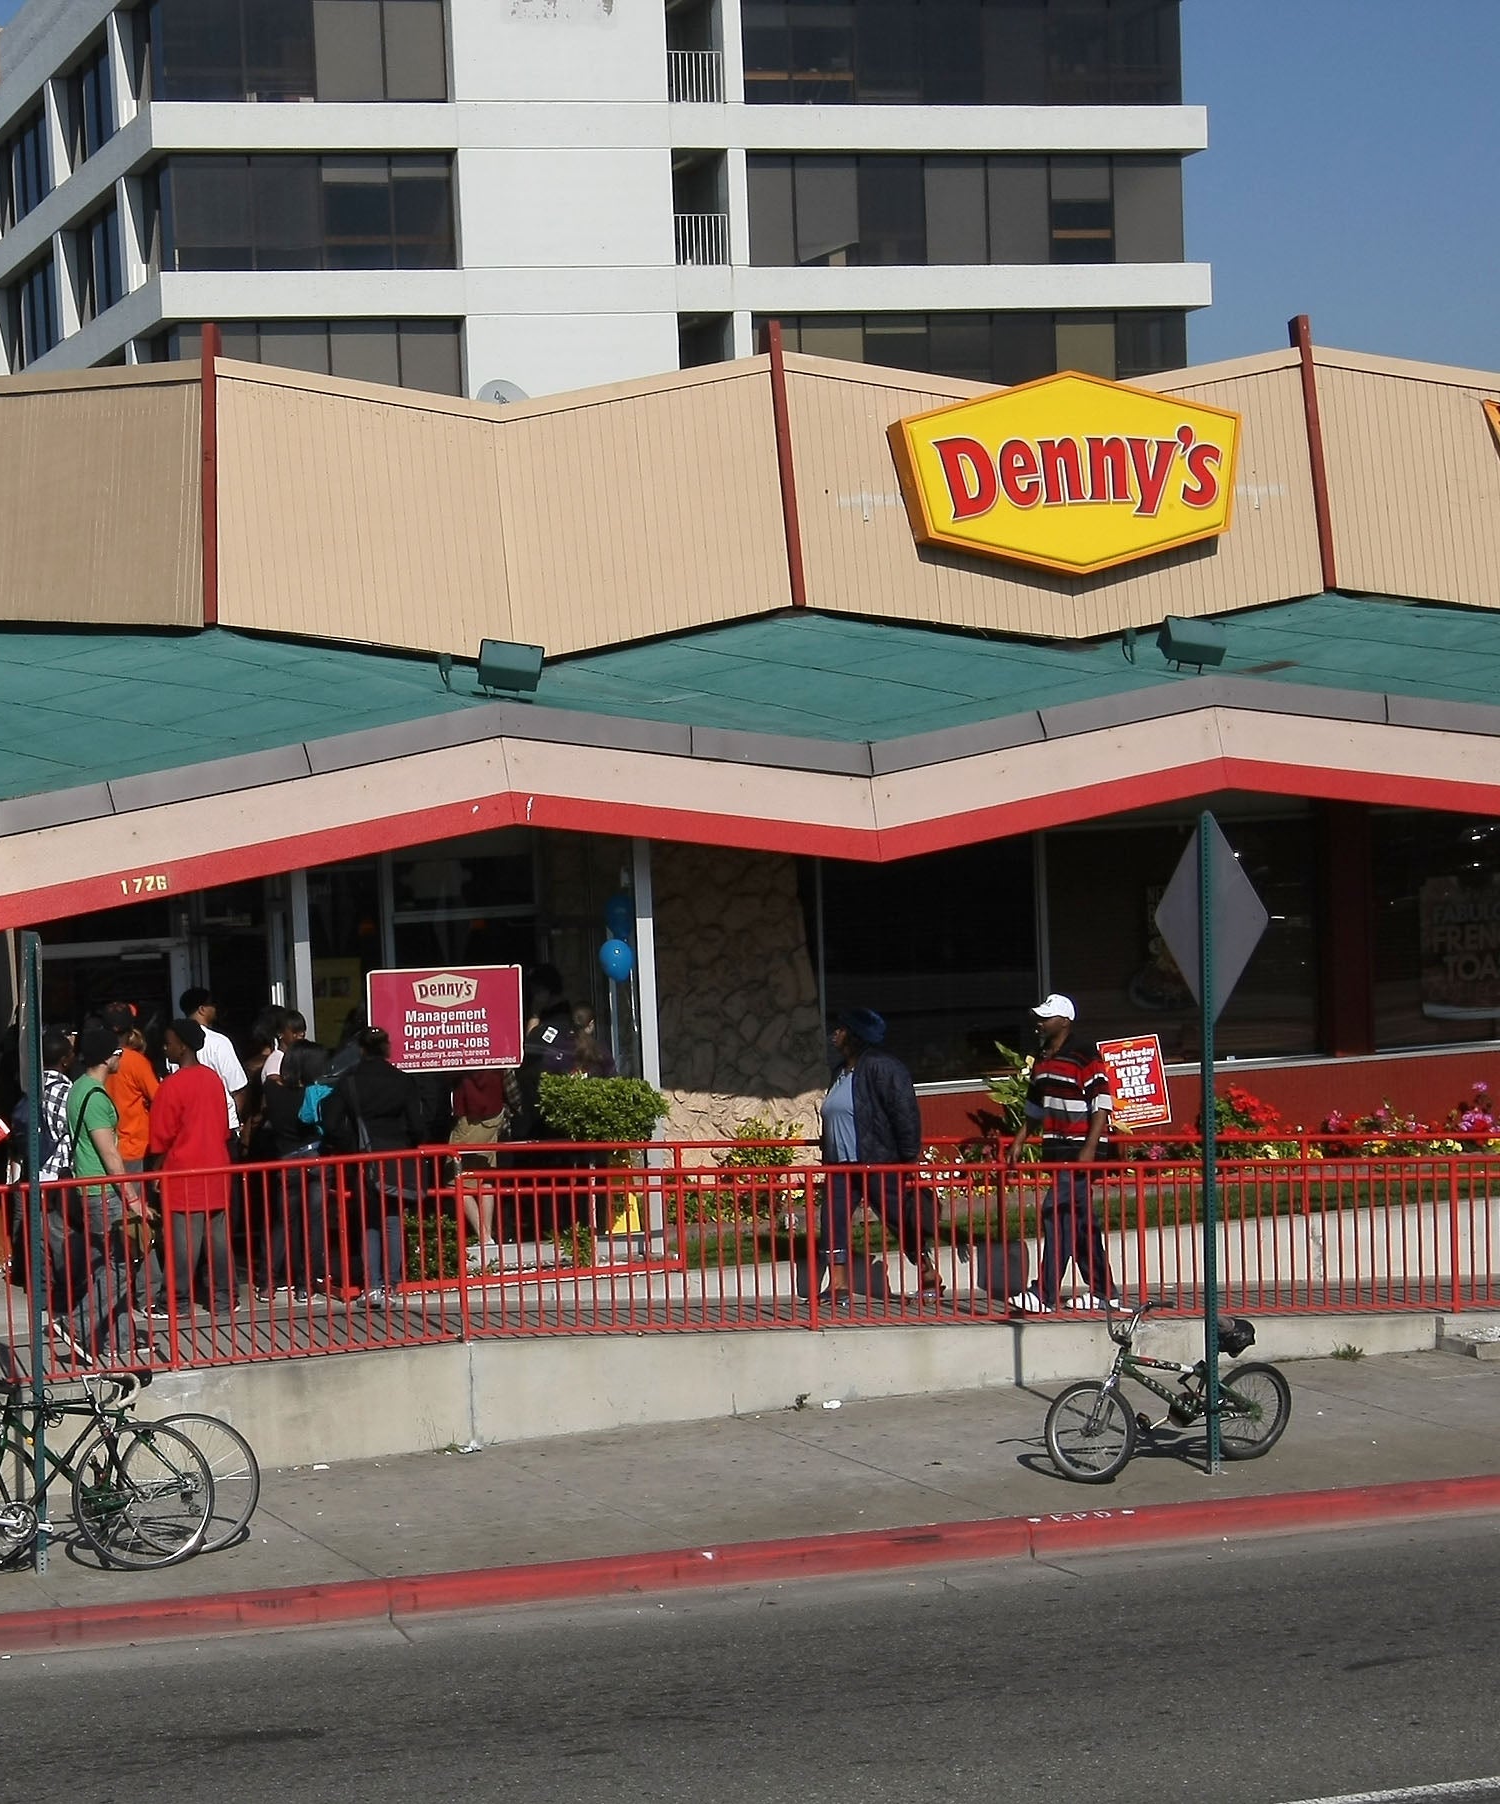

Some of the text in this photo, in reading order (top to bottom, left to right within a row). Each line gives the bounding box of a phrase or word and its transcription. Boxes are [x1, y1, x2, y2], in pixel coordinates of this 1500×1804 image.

[932, 424, 1223, 521] Denny's
[417, 980, 473, 999] Denny's
[405, 1007, 486, 1023] Management
[404, 1021, 489, 1039] Opportunities
[403, 1037, 490, 1051] 1-888-OUR-JOBS
[484, 1056, 517, 1066] prompted
[1115, 1064, 1150, 1079] KIDS
[1121, 1075, 1147, 1088] EAT
[1116, 1083, 1156, 1099] FREE!
